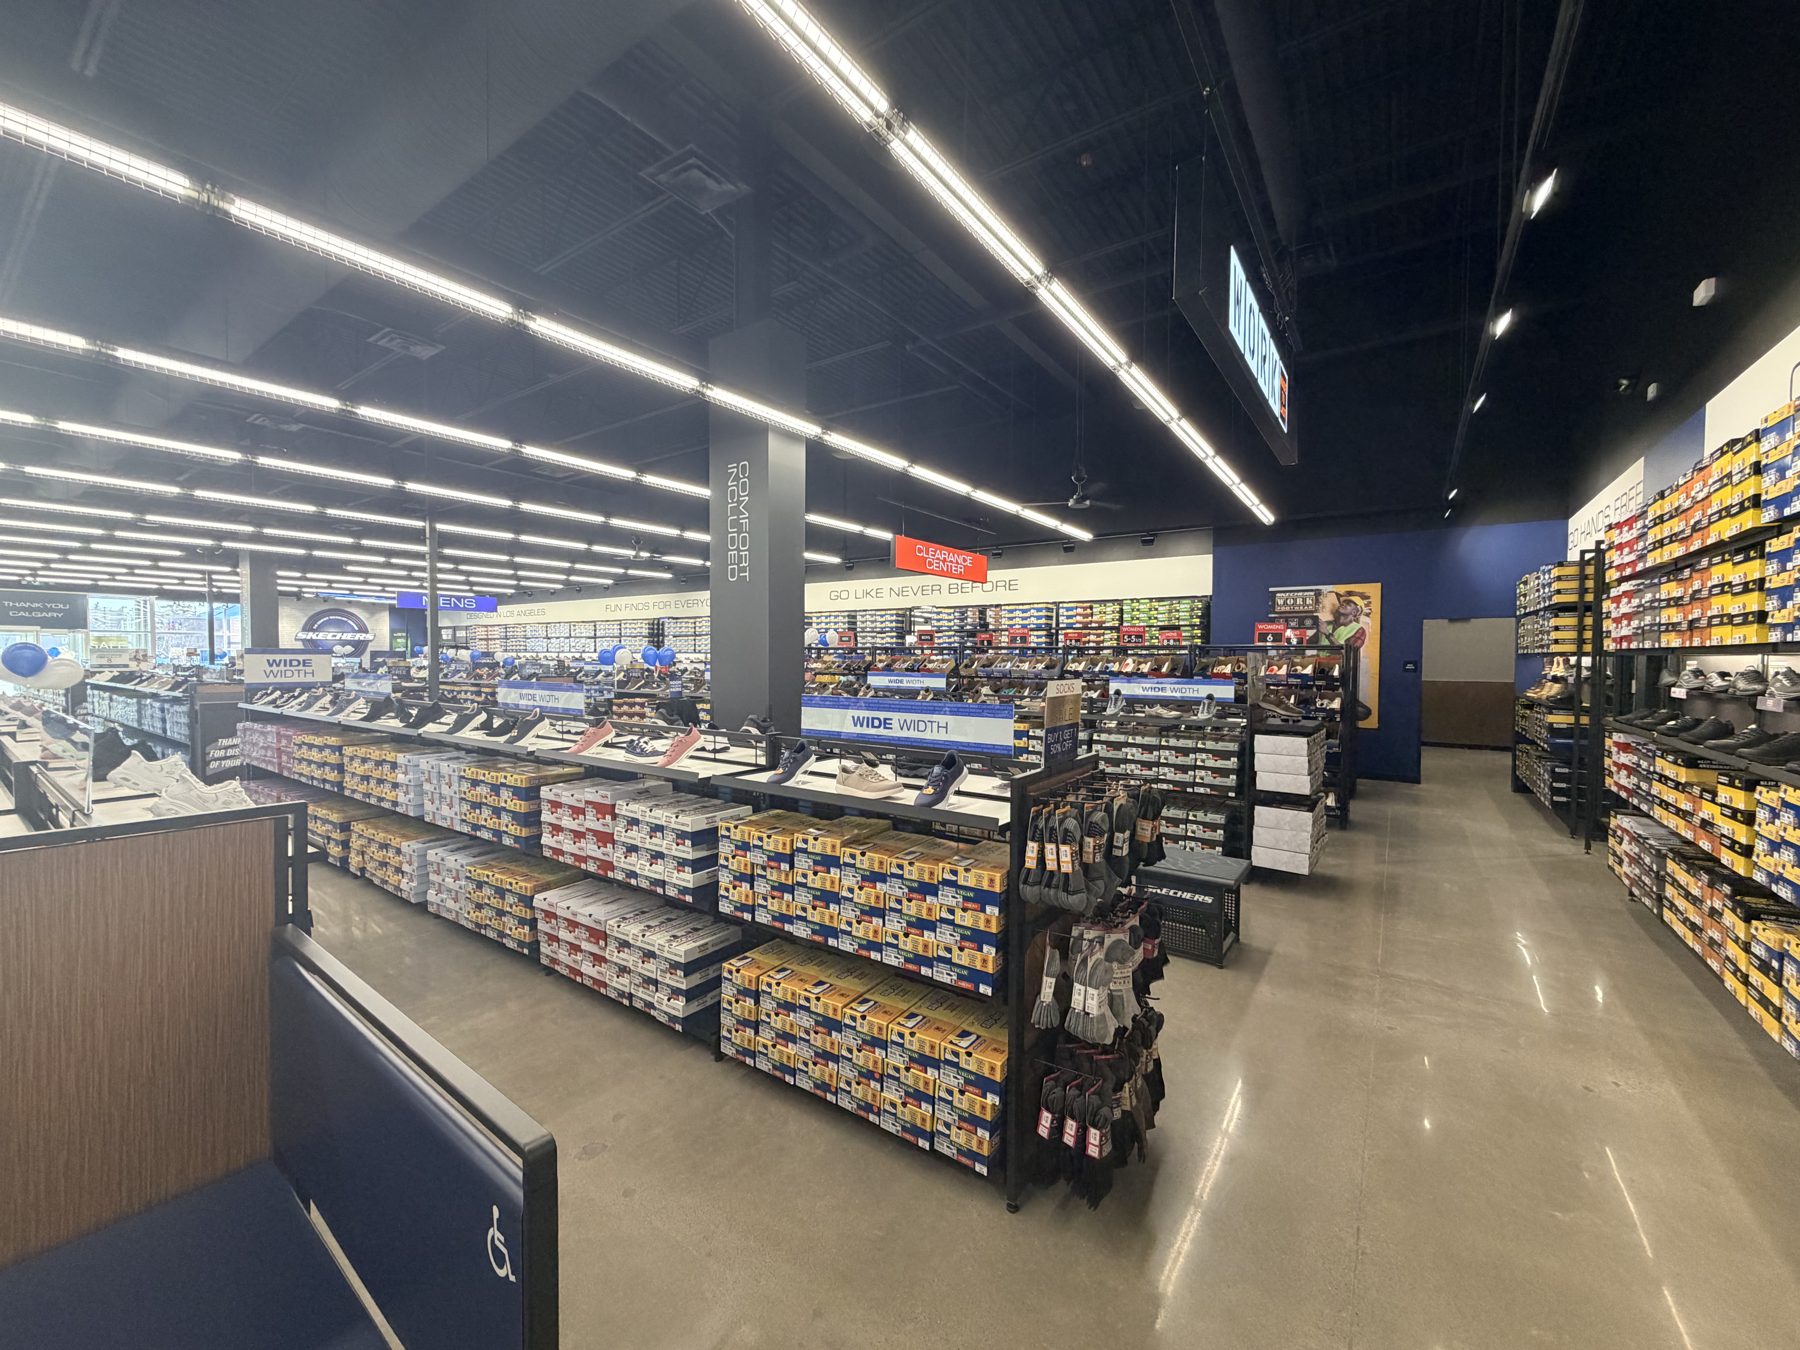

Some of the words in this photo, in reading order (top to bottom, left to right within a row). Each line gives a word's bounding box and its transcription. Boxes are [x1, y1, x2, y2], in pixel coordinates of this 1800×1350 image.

[1233, 263, 1278, 407] WORK
[727, 463, 738, 581] INCLUDED
[738, 461, 749, 581] COMFORT
[1580, 505, 1610, 544] HANDS
[915, 545, 973, 566] CLEARANCE
[926, 558, 964, 575] CENTER
[830, 589, 850, 600] GO
[854, 588, 884, 599] LIKE
[890, 584, 942, 598] NEVER
[948, 579, 1019, 594] BEFORE
[606, 604, 622, 612] FUN
[624, 602, 650, 612] FINDS
[652, 600, 672, 610] FOR
[516, 608, 545, 616] ANGELES
[296, 632, 374, 640] SKECHERS
[266, 659, 312, 667] WIDE
[264, 669, 314, 678] WIDTH
[1056, 683, 1074, 694] SOCKS
[520, 693, 537, 702] WIDE
[538, 694, 560, 703] WIDTH
[852, 715, 893, 730] WIDE
[898, 718, 948, 734] WIDTH
[1048, 732, 1059, 743] BUY
[1063, 729, 1073, 739] GET
[1062, 740, 1072, 751] OFF
[221, 759, 241, 767] YOUR
[957, 889, 974, 898] VEGAN
[955, 926, 971, 935] VEGAN
[952, 966, 968, 976] VEGAN
